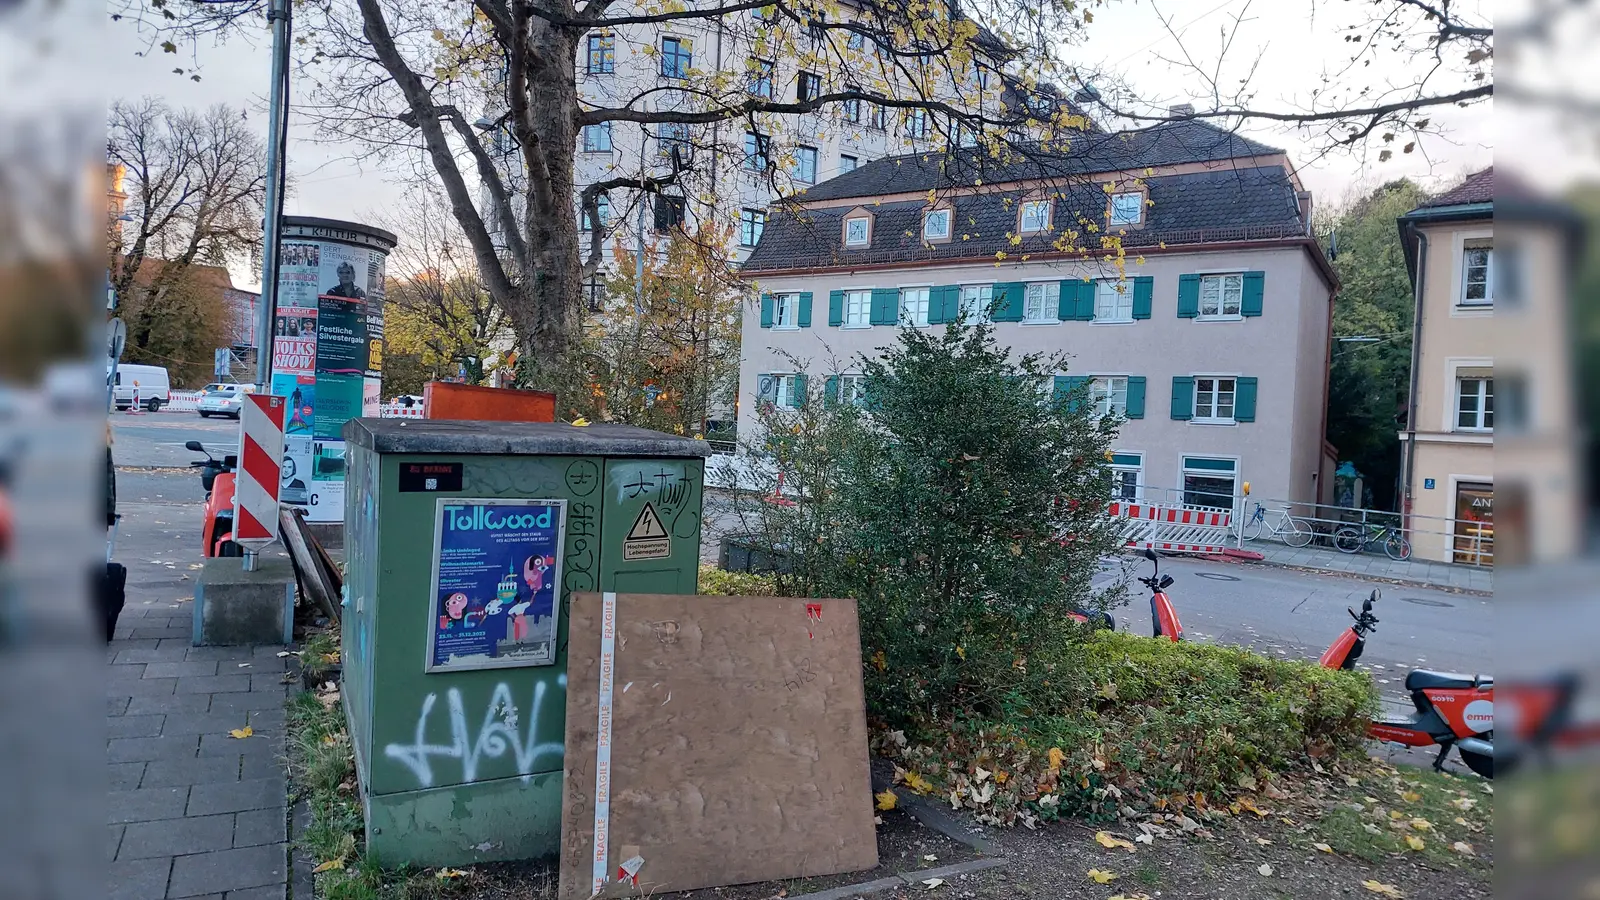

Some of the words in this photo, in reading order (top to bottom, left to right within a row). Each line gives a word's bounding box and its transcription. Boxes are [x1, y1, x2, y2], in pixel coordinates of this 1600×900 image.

[312, 226, 357, 241] KULTUR
[323, 245, 342, 253] GERT
[319, 325, 353, 335] Festliche
[318, 333, 365, 344] Silvestergala
[274, 341, 315, 356] VOLKS
[274, 354, 315, 369] SHOW
[313, 443, 323, 456] M
[310, 493, 319, 506] C
[443, 505, 552, 531] Tollwood
[627, 542, 668, 551] Hochspannung
[628, 548, 667, 556] Lebensgefahr
[604, 601, 614, 639] FRAGILE
[602, 652, 612, 692] FRAGILE
[600, 704, 610, 747] FRAGILE
[598, 761, 608, 803] FRAGILE
[596, 818, 606, 862] FRAGILE
